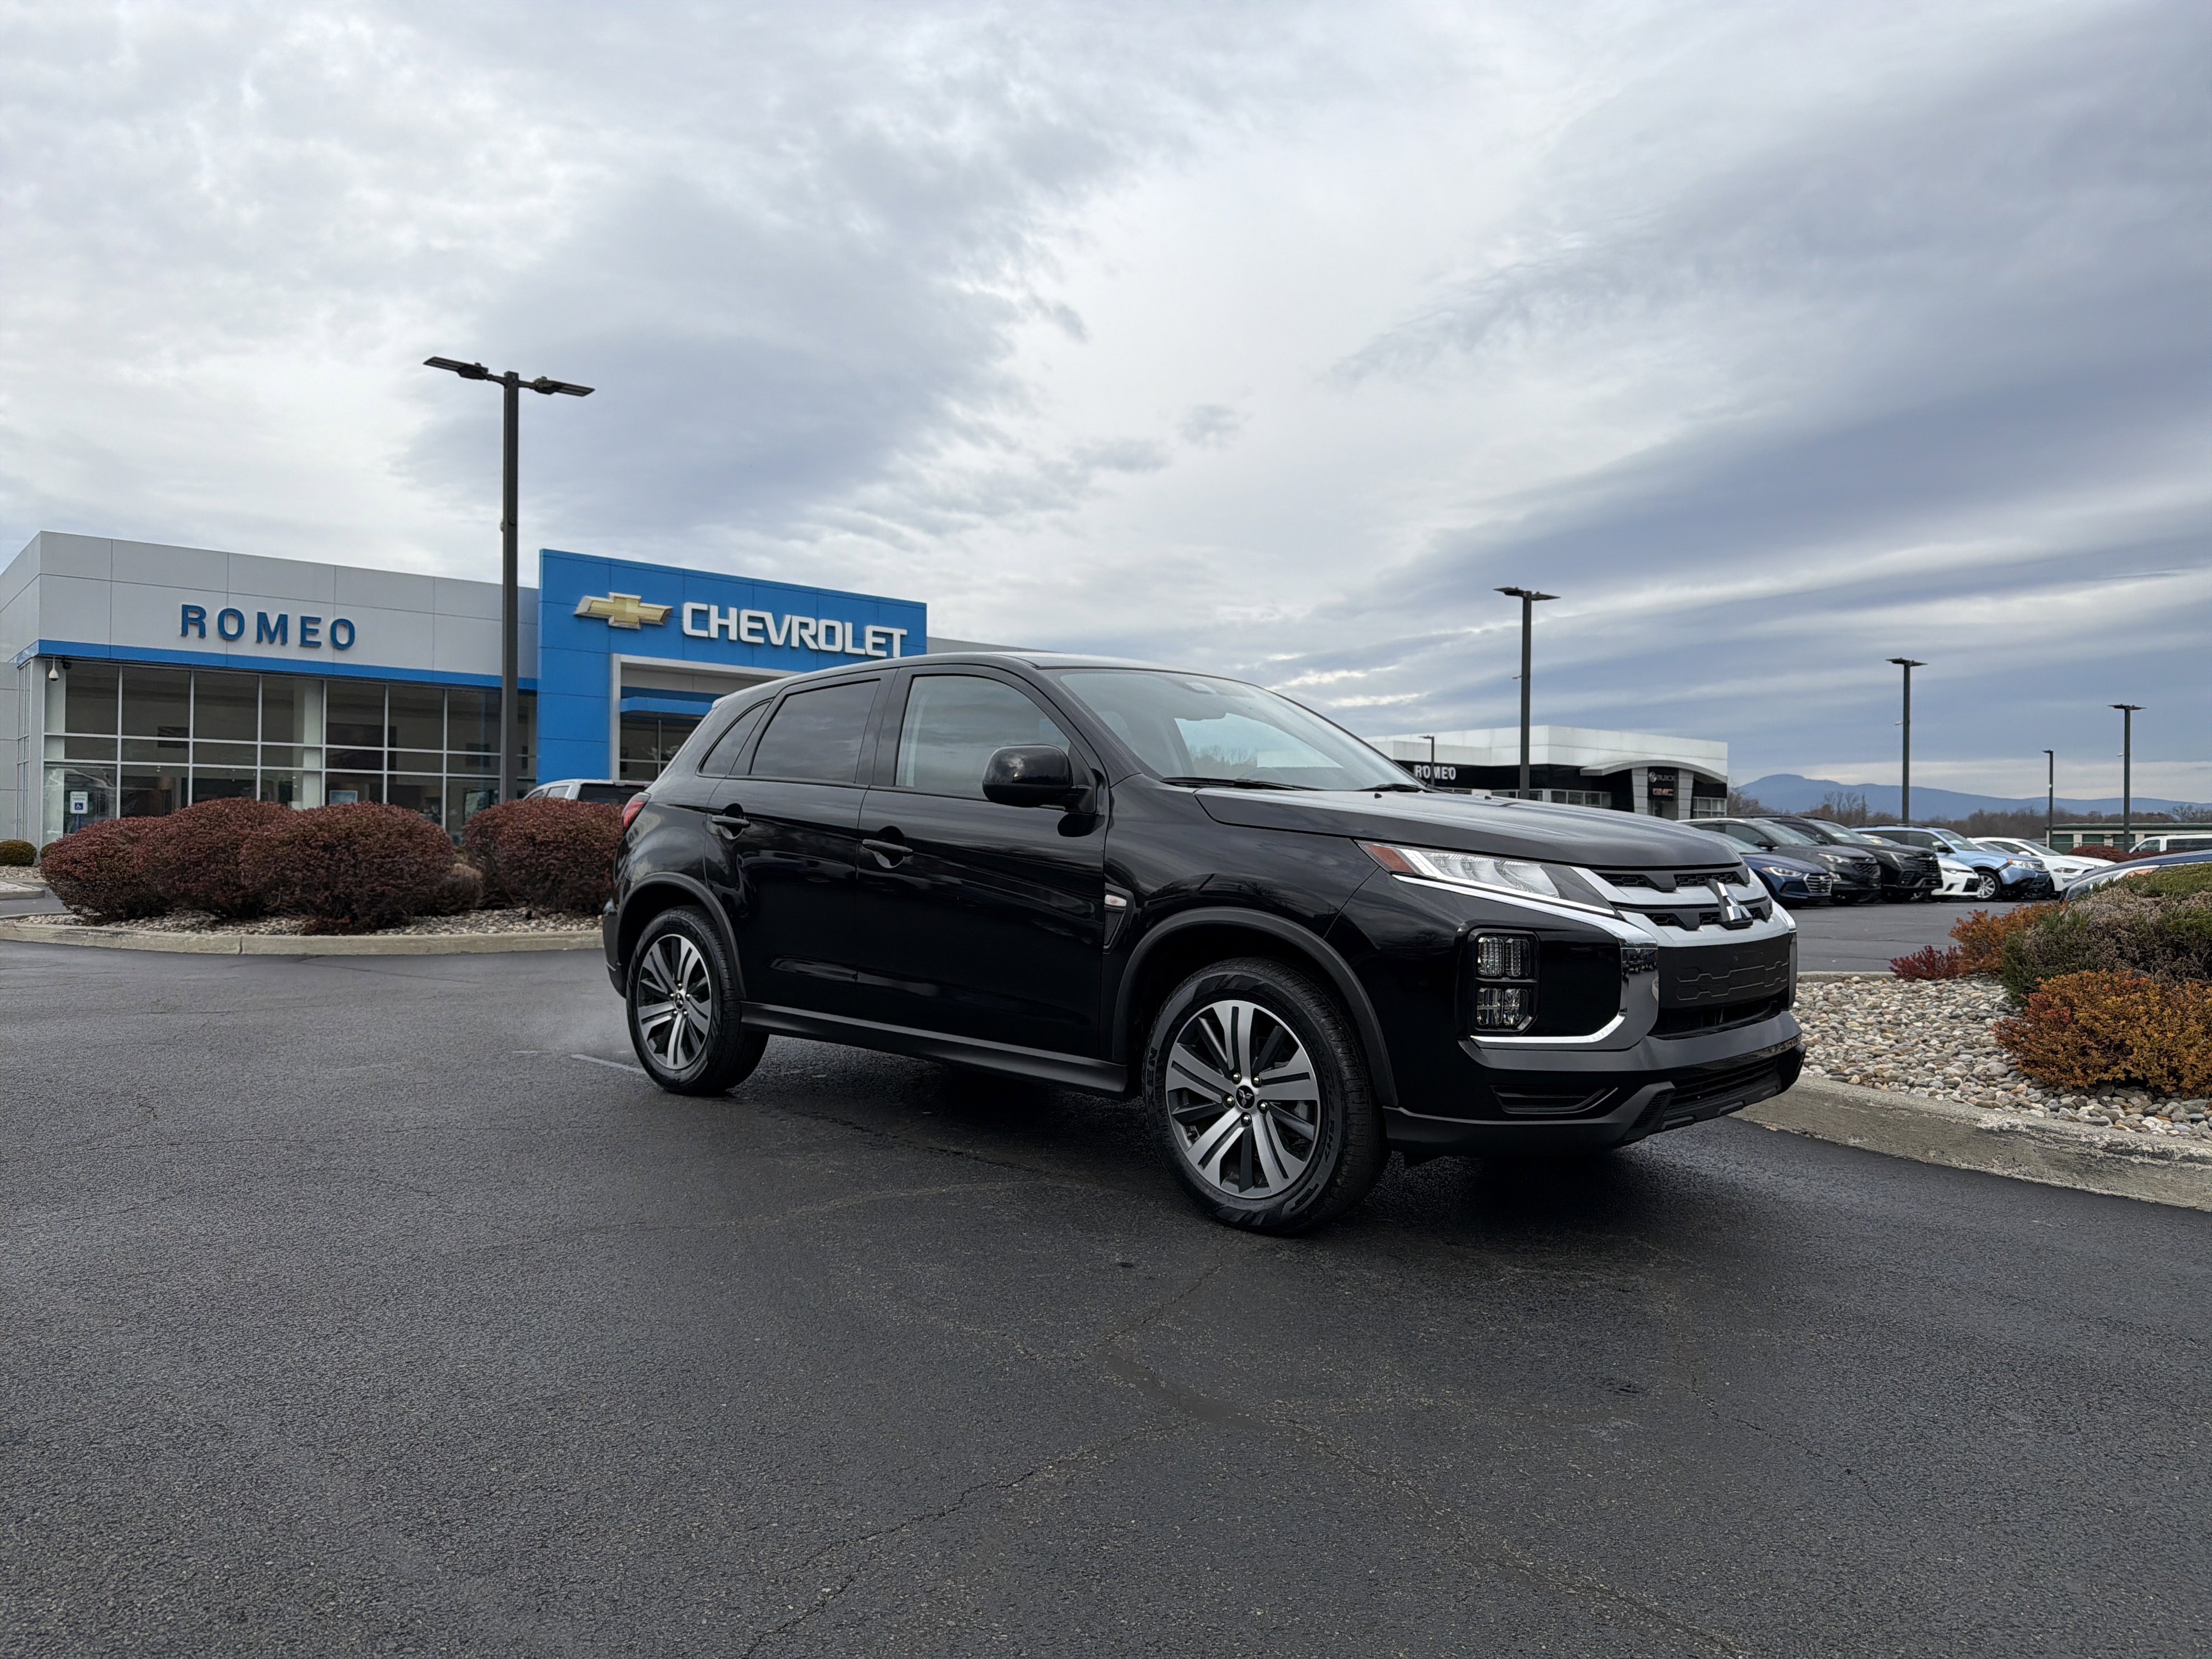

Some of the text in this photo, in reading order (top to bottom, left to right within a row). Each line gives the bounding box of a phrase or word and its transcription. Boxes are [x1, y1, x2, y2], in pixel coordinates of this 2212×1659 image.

[180, 603, 356, 650] ROMEO
[683, 602, 908, 658] CHEVROLET
[1414, 764, 1456, 780] ROMEO
